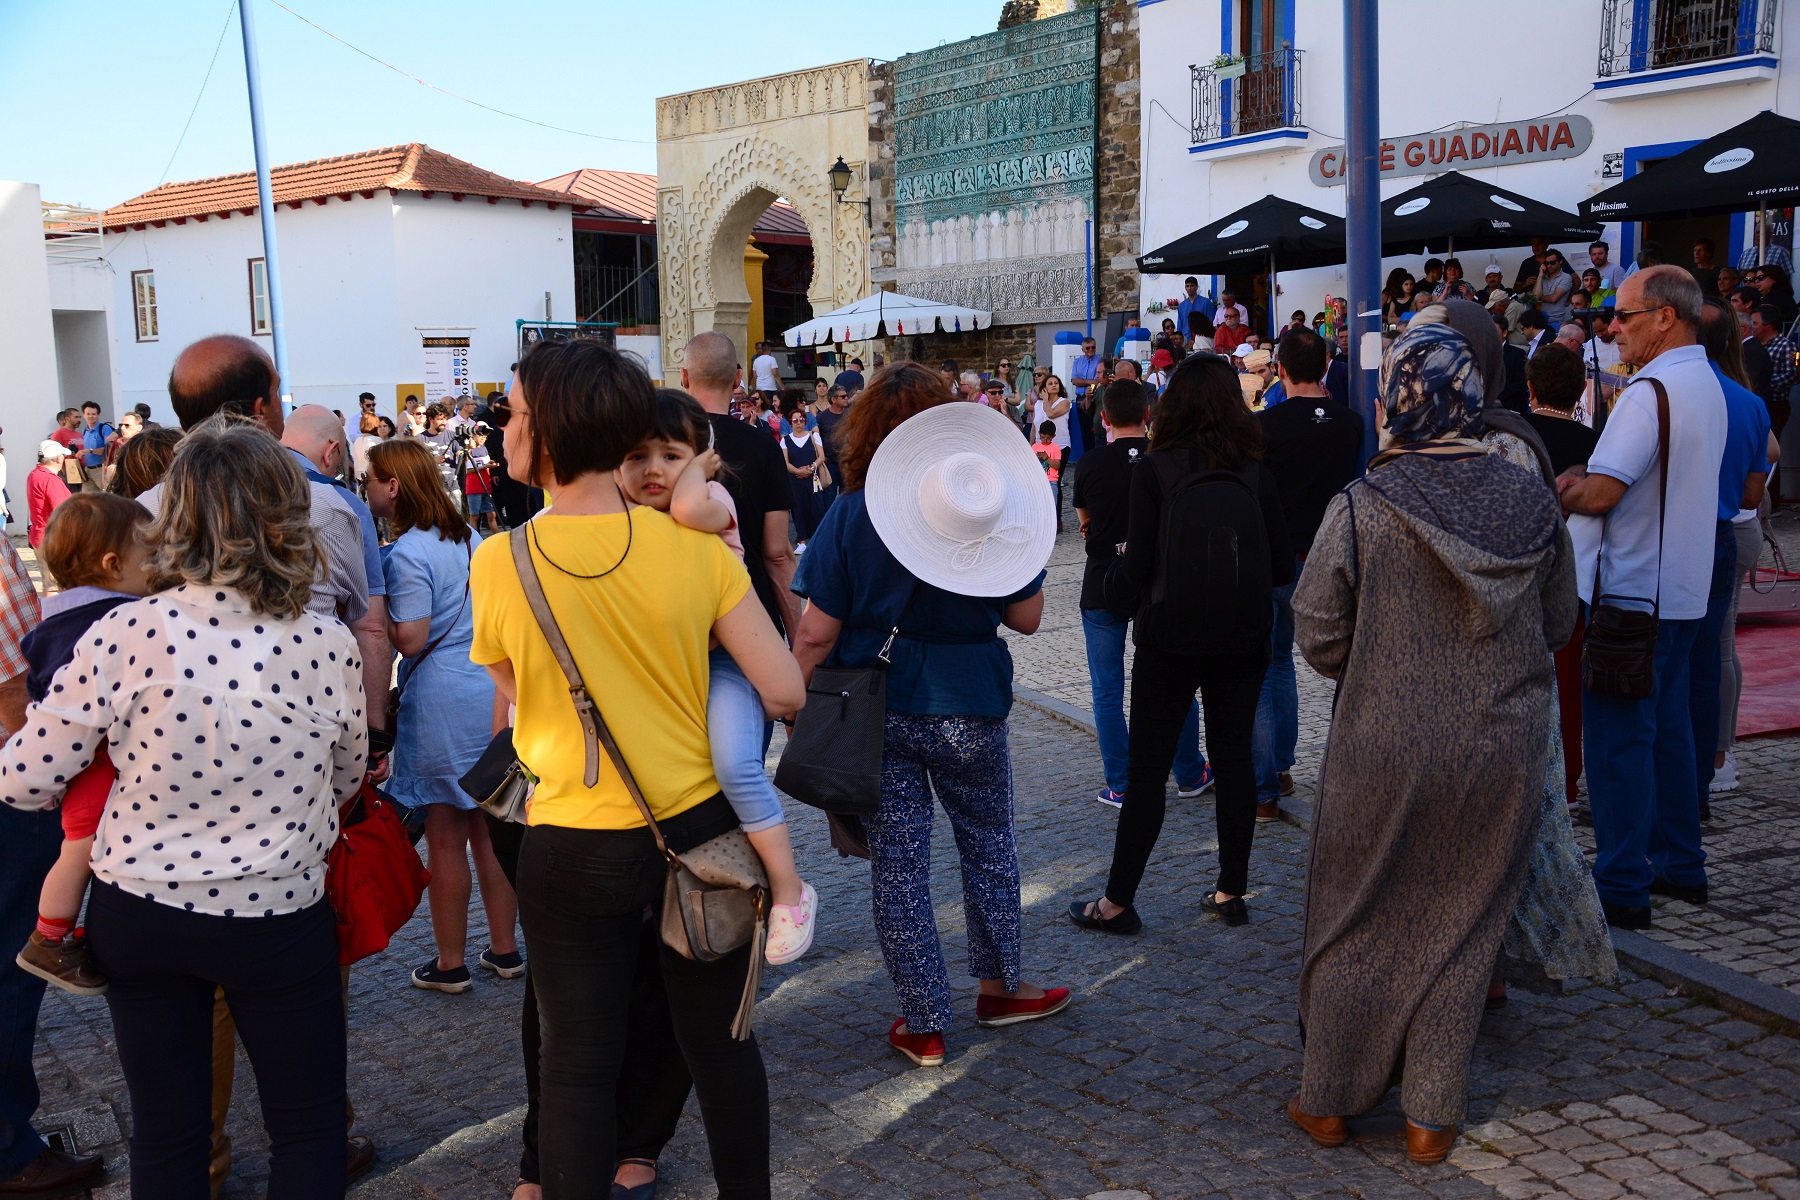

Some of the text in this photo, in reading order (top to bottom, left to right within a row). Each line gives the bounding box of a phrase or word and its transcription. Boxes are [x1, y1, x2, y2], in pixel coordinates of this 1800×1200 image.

[1319, 121, 1575, 178] CÉ GUADIANA
[1778, 185, 1799, 193] DELLA
